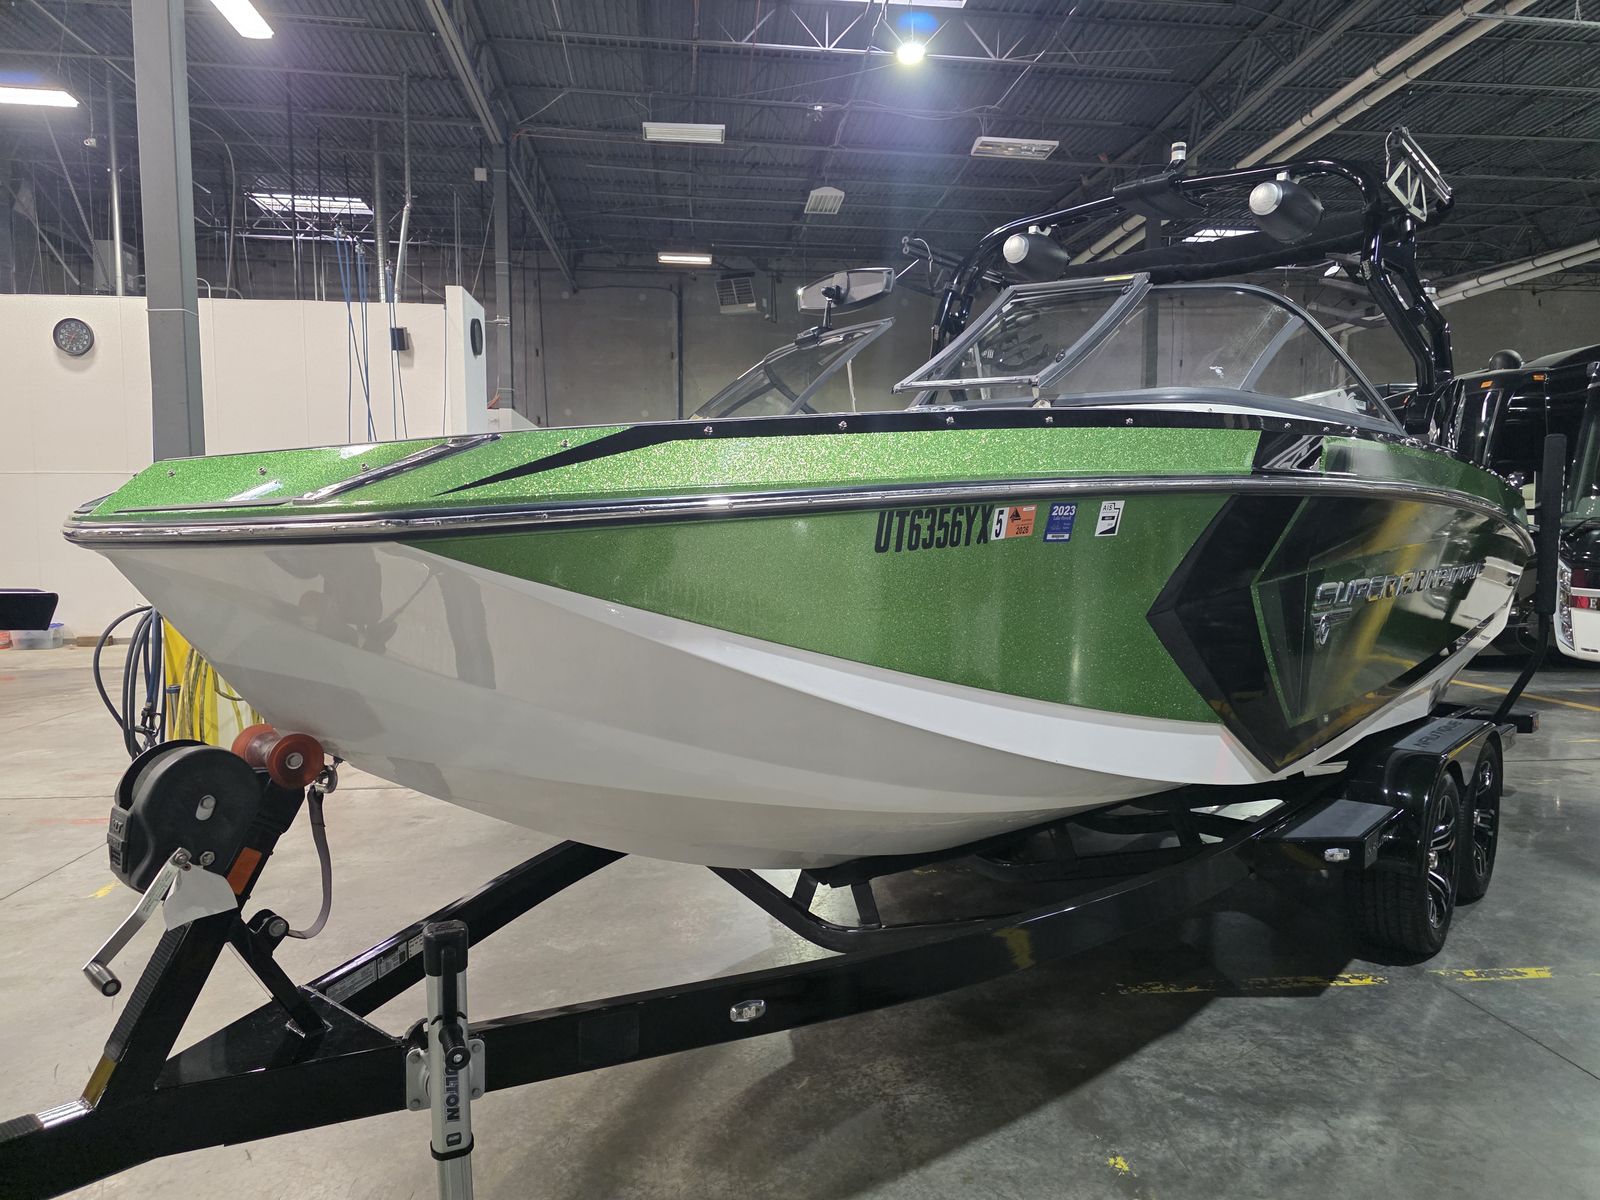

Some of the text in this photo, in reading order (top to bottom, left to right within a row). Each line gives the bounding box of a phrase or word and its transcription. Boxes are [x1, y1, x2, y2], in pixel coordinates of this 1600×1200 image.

[995, 509, 1004, 538] 5
[1052, 505, 1076, 516] 2023
[874, 504, 994, 553] UT6356YX
